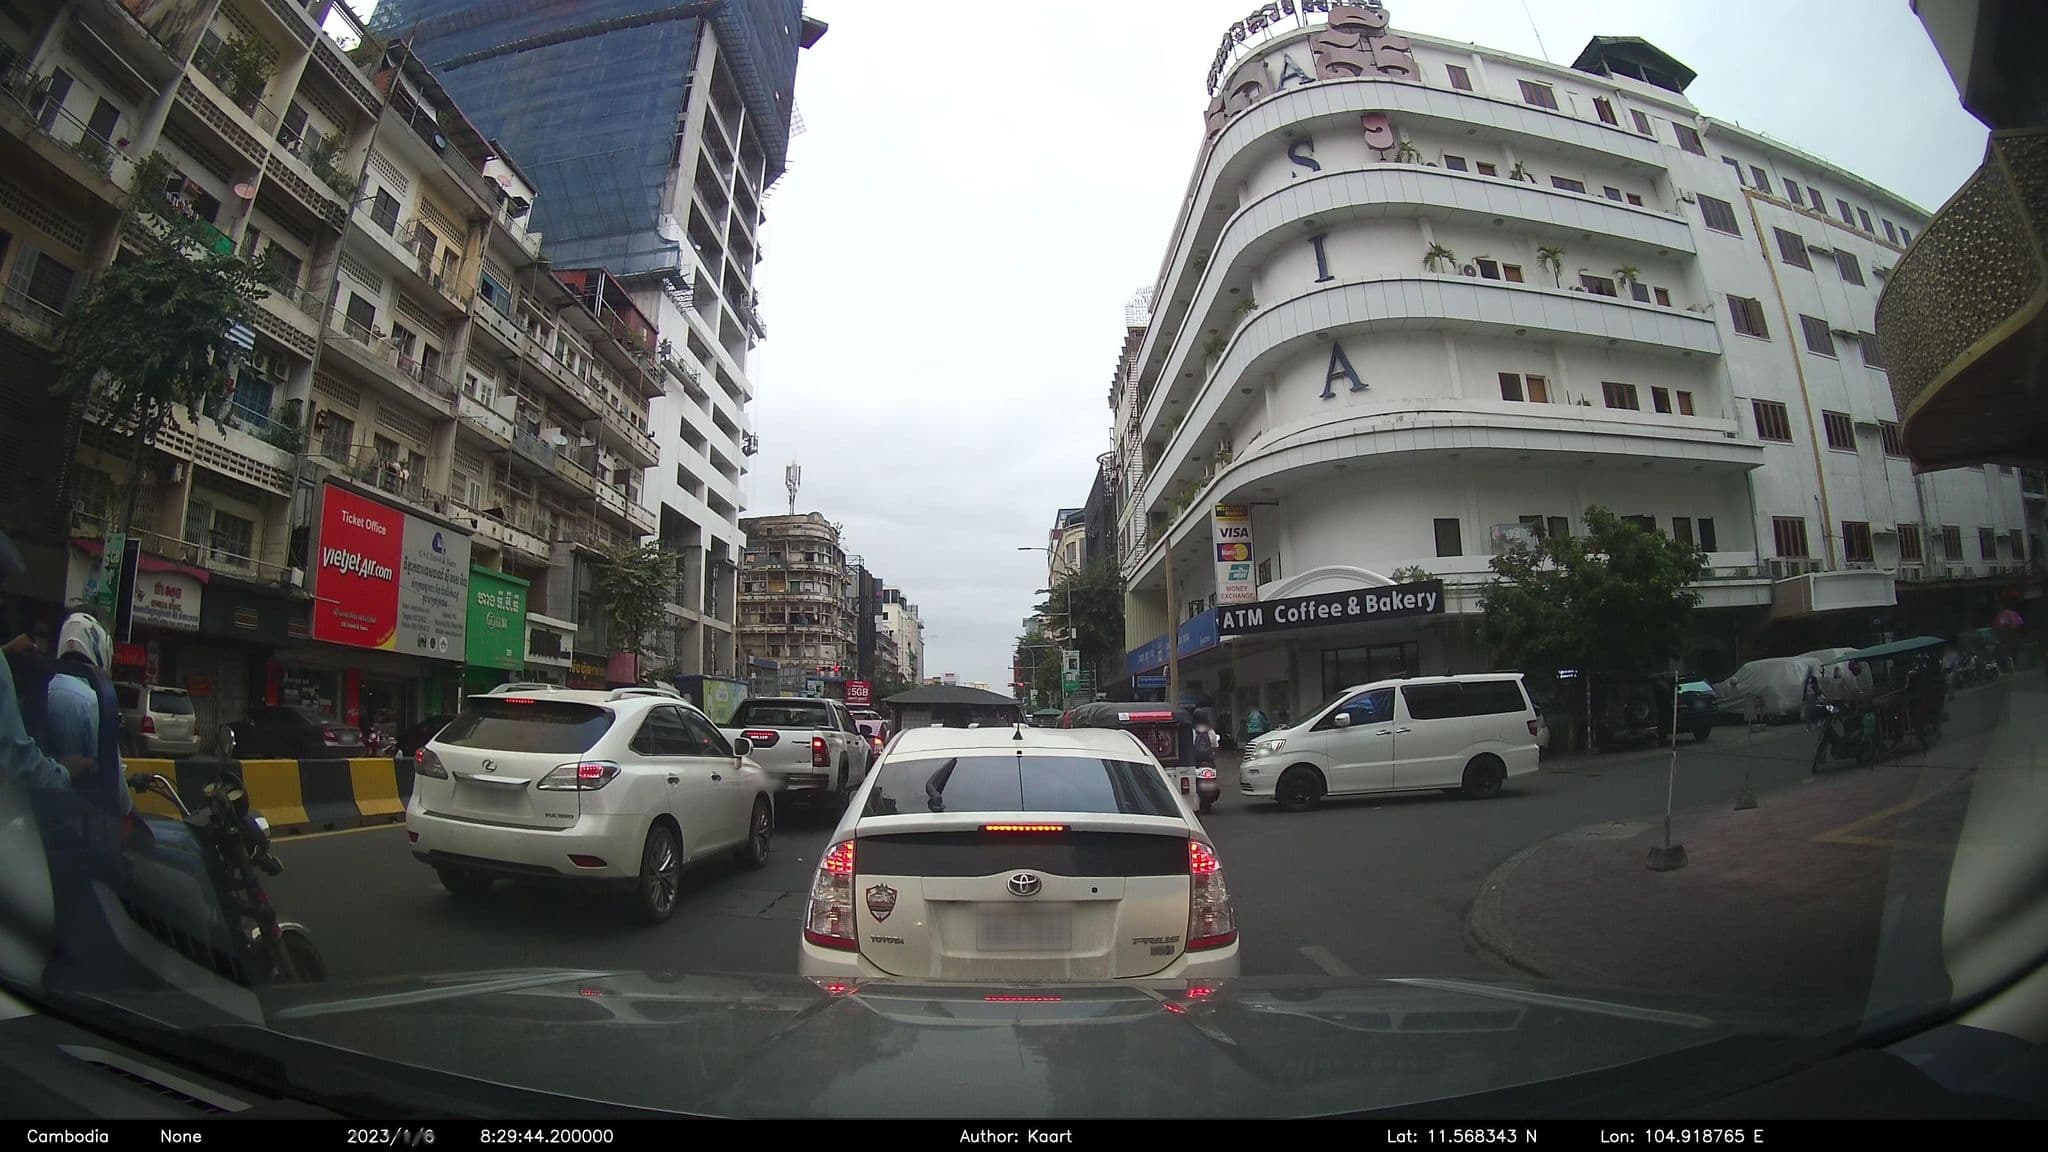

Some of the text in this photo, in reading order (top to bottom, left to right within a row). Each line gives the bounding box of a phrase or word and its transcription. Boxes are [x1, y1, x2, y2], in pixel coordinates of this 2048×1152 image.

[341, 510, 387, 535] Ticket Office
[1220, 527, 1249, 538] VISA
[1225, 585, 1248, 594] MONEY
[1223, 589, 1438, 630] ATM Coffee & Bakery
[851, 688, 869, 697] 5GB
